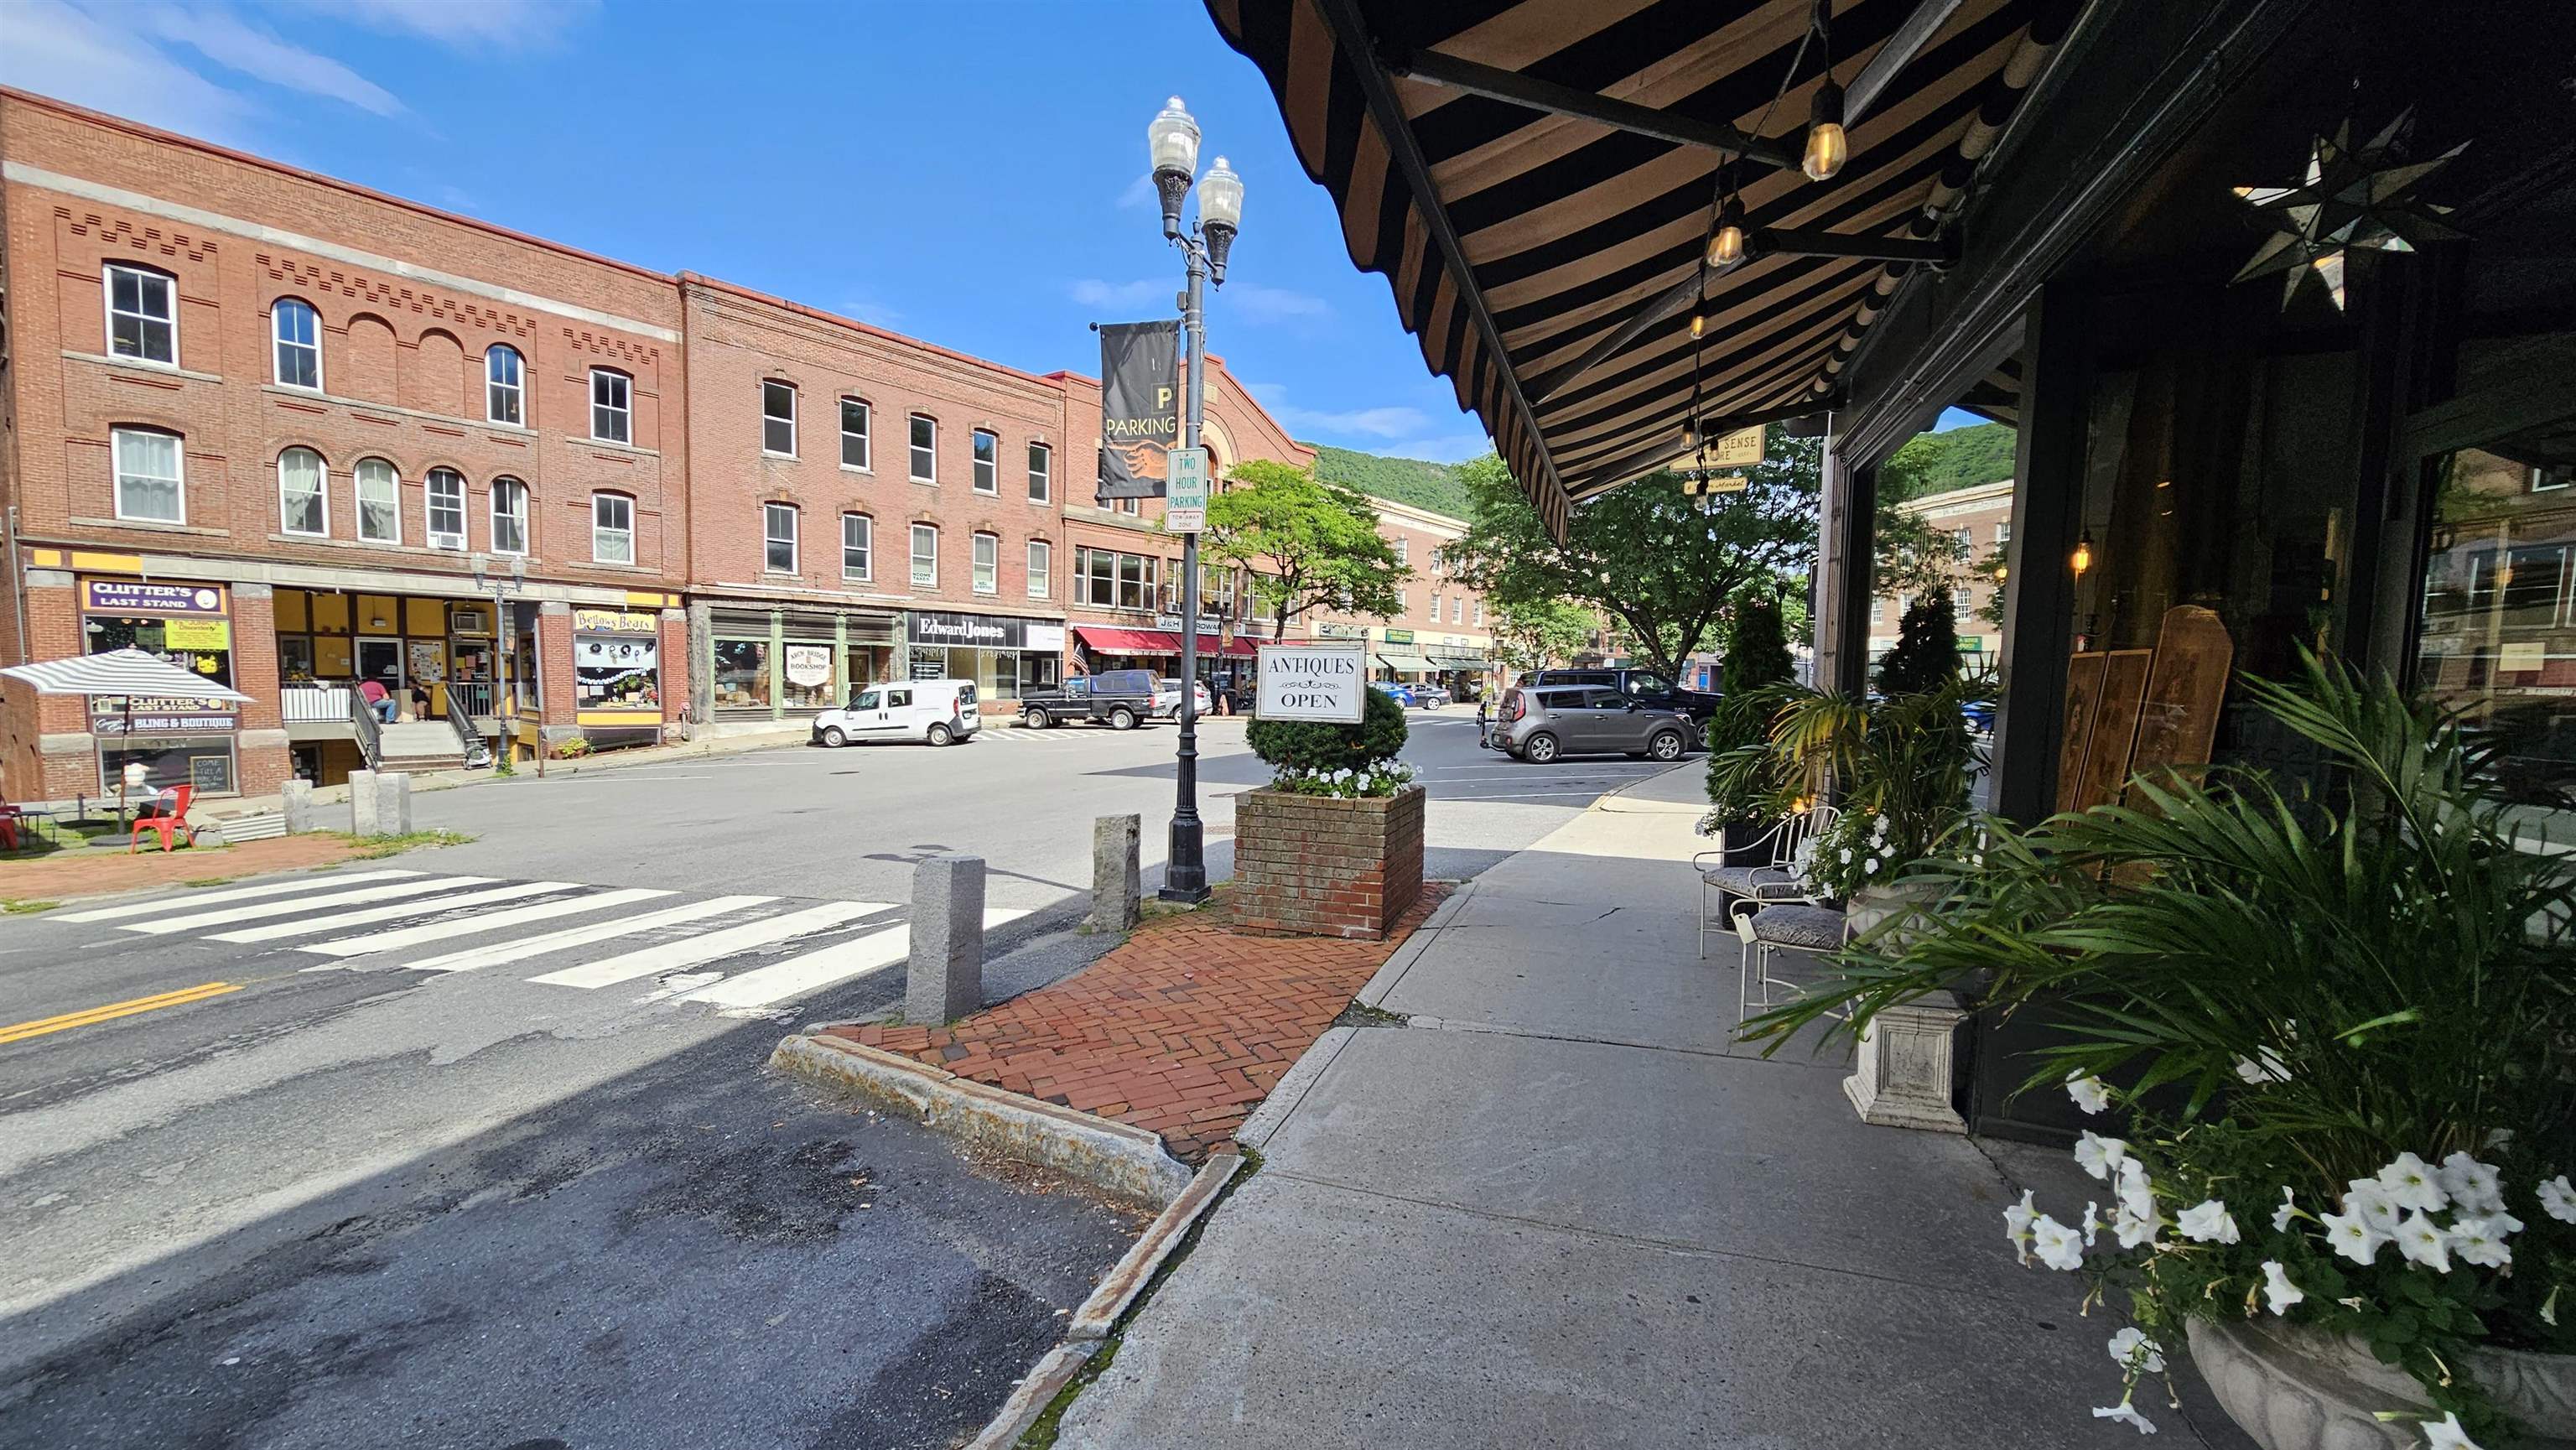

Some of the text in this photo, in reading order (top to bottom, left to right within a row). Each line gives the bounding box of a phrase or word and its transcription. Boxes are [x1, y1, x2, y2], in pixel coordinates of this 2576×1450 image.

[1158, 387, 1172, 409] P
[1107, 416, 1176, 436] PARKING
[1724, 436, 1757, 449] SENSE
[1179, 458, 1196, 470] TWO
[1176, 476, 1197, 489] HOUR
[1170, 496, 1202, 508] PARKING
[92, 582, 192, 597] CLUTTER'S
[101, 597, 187, 608] LAST STAND
[578, 612, 616, 627] Bellows
[920, 618, 1005, 638] Edward Jones
[1269, 657, 1355, 677] ANTIQUES
[128, 698, 207, 706] CLUTTER'S
[1281, 694, 1338, 709] OPEN
[134, 719, 168, 728] BLING
[169, 719, 179, 728] &
[180, 718, 233, 728] BOUTIQUE
